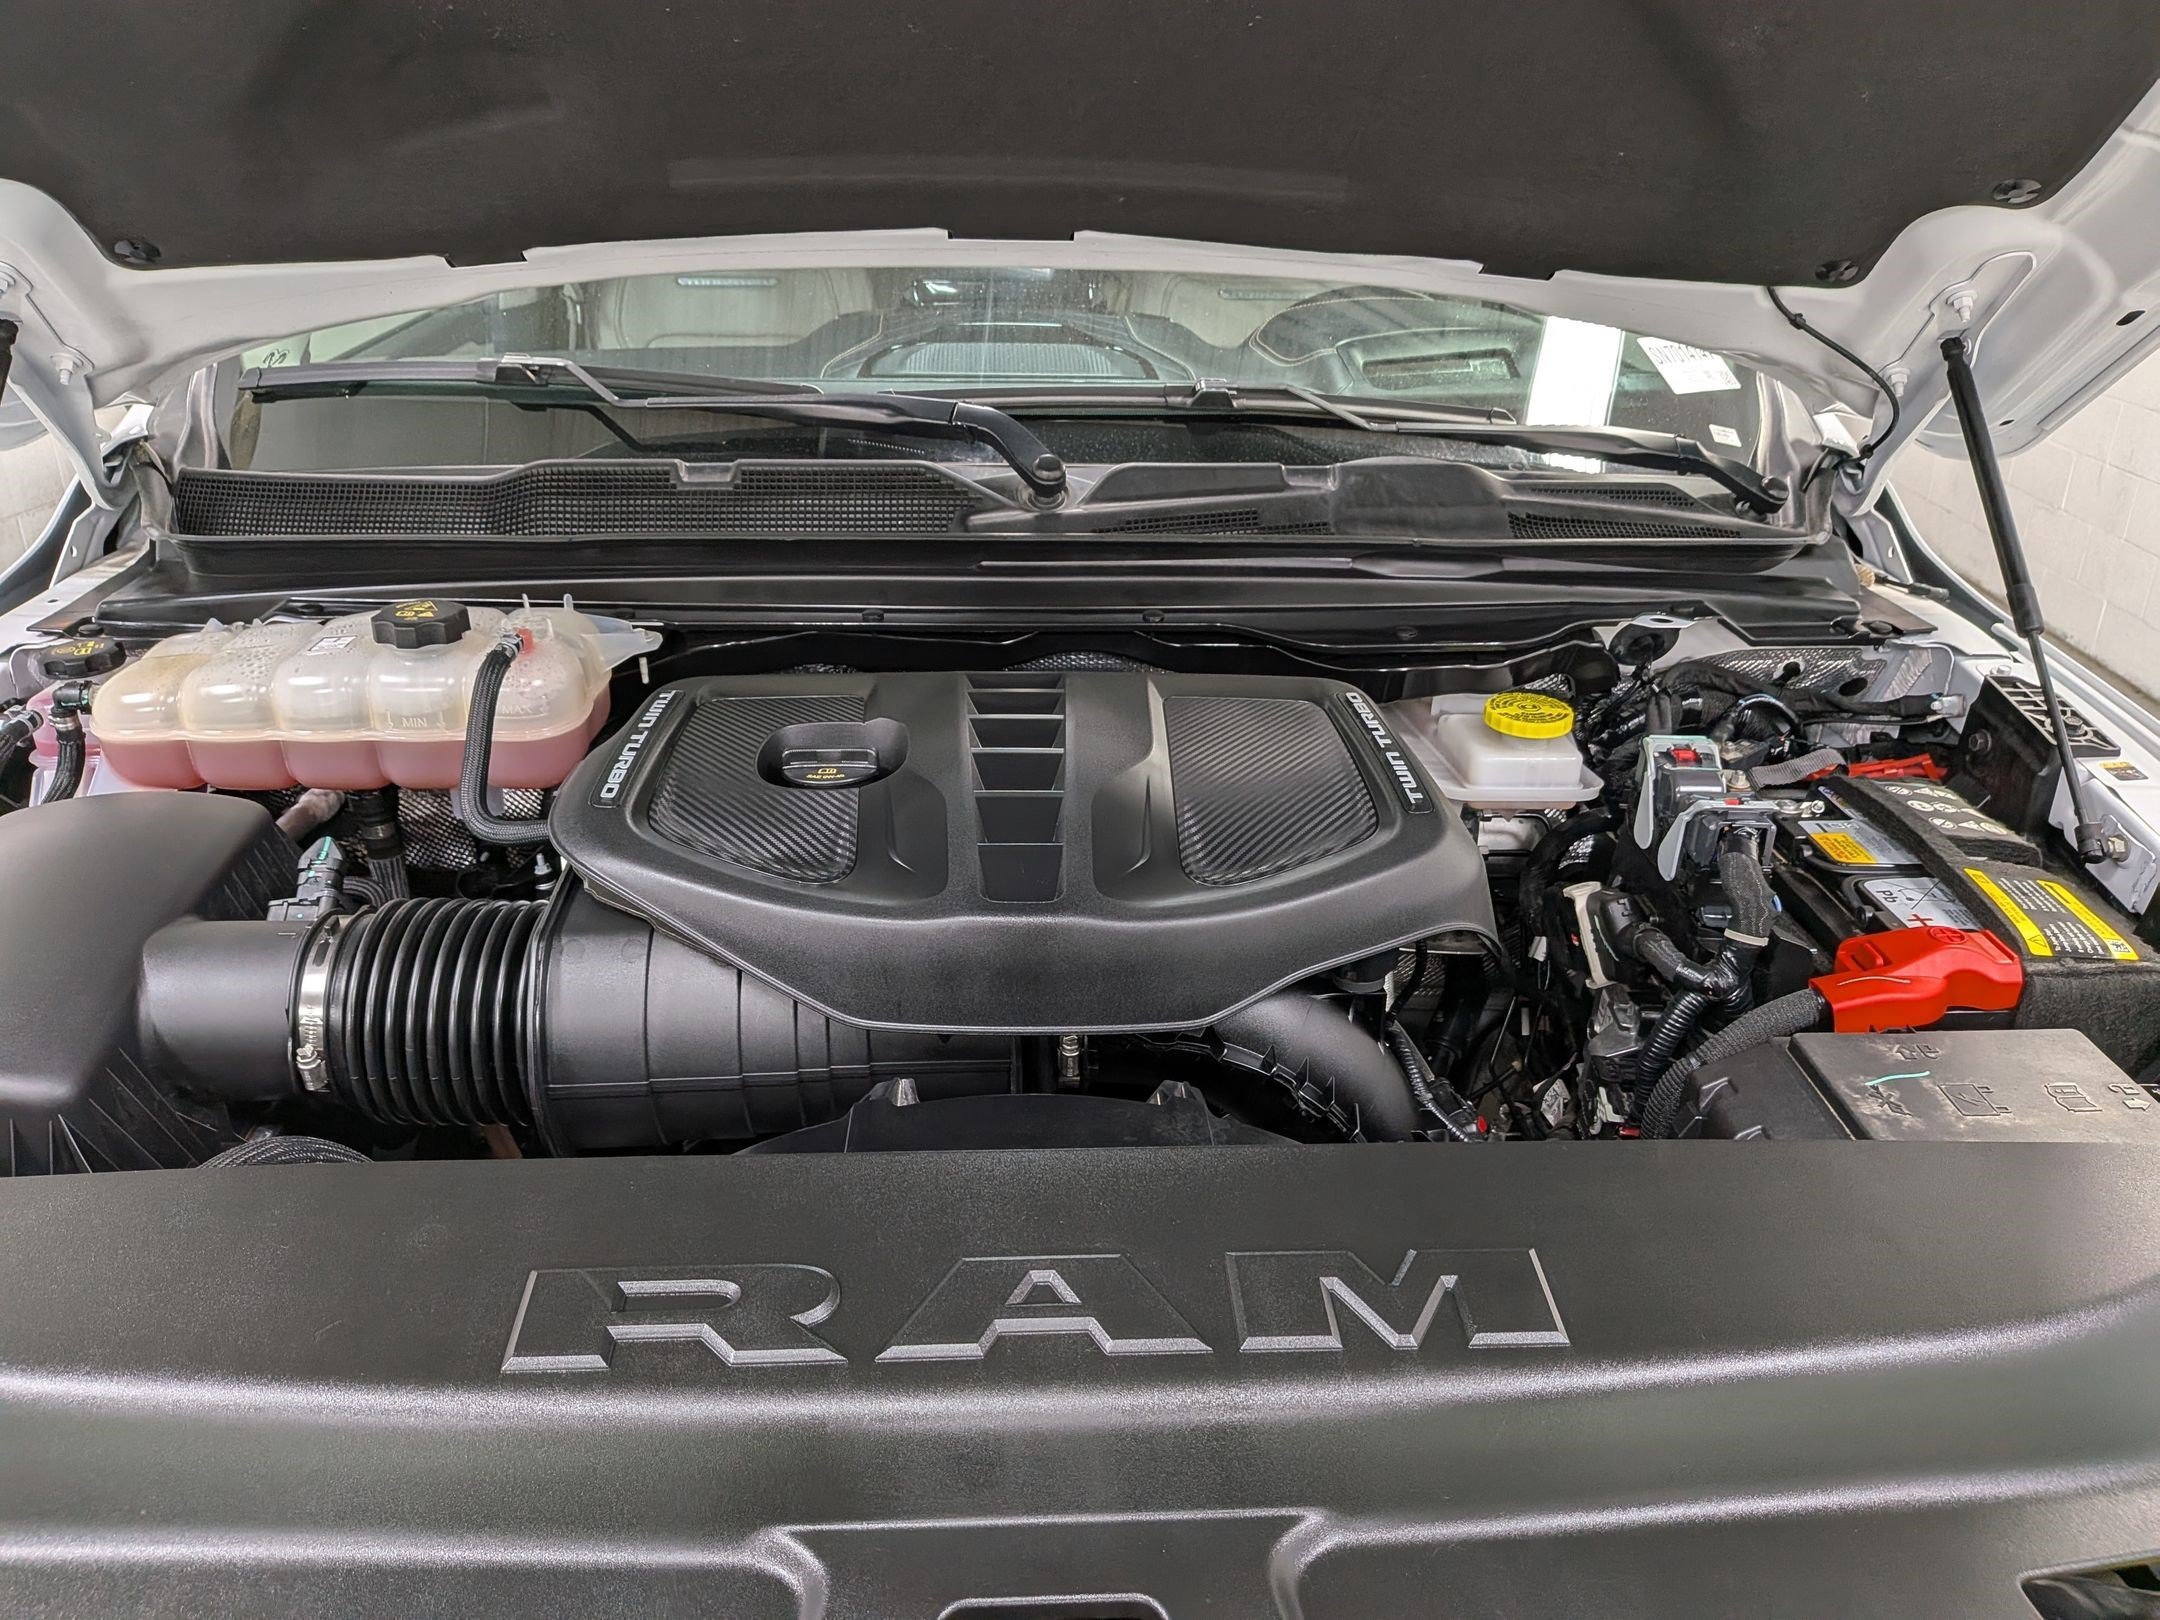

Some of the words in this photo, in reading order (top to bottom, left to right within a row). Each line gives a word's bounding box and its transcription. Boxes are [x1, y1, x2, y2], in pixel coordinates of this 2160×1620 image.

[402, 717, 427, 728] MIN
[502, 705, 532, 714] MAX
[638, 690, 676, 728] TWIN
[1346, 692, 1393, 748] TURBO
[600, 730, 649, 798] TURBO
[1386, 752, 1423, 804] TWIN
[1875, 890, 1898, 902] Pb
[501, 1247, 1571, 1373] RAM
